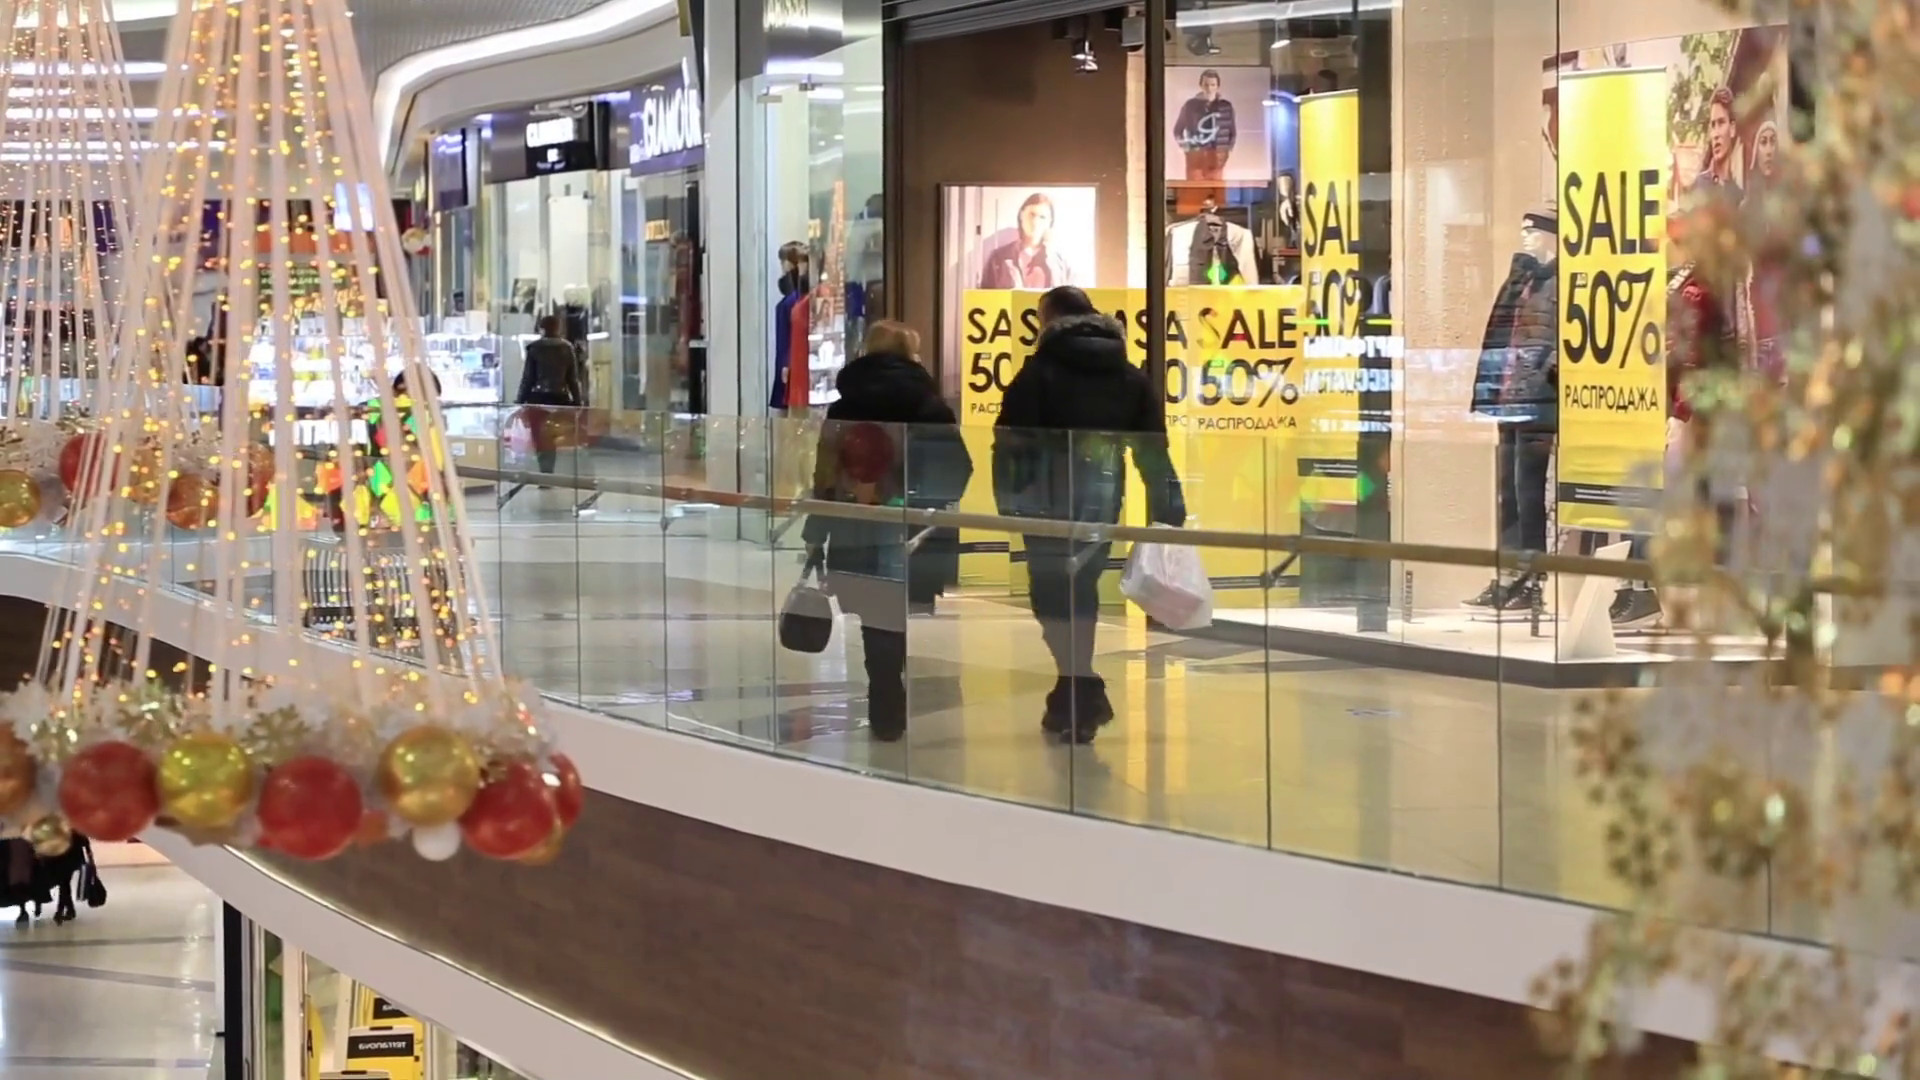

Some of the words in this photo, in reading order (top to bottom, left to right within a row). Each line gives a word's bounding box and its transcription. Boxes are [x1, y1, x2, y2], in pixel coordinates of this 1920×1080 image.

[1563, 169, 1660, 257] SALE
[967, 308, 1012, 344] SA
[1196, 307, 1297, 350] SALE
[1563, 267, 1661, 369] 50%
[1565, 384, 1660, 413] РАСПРОДАЖА
[1197, 416, 1297, 431] РАСПРОДАЖА
